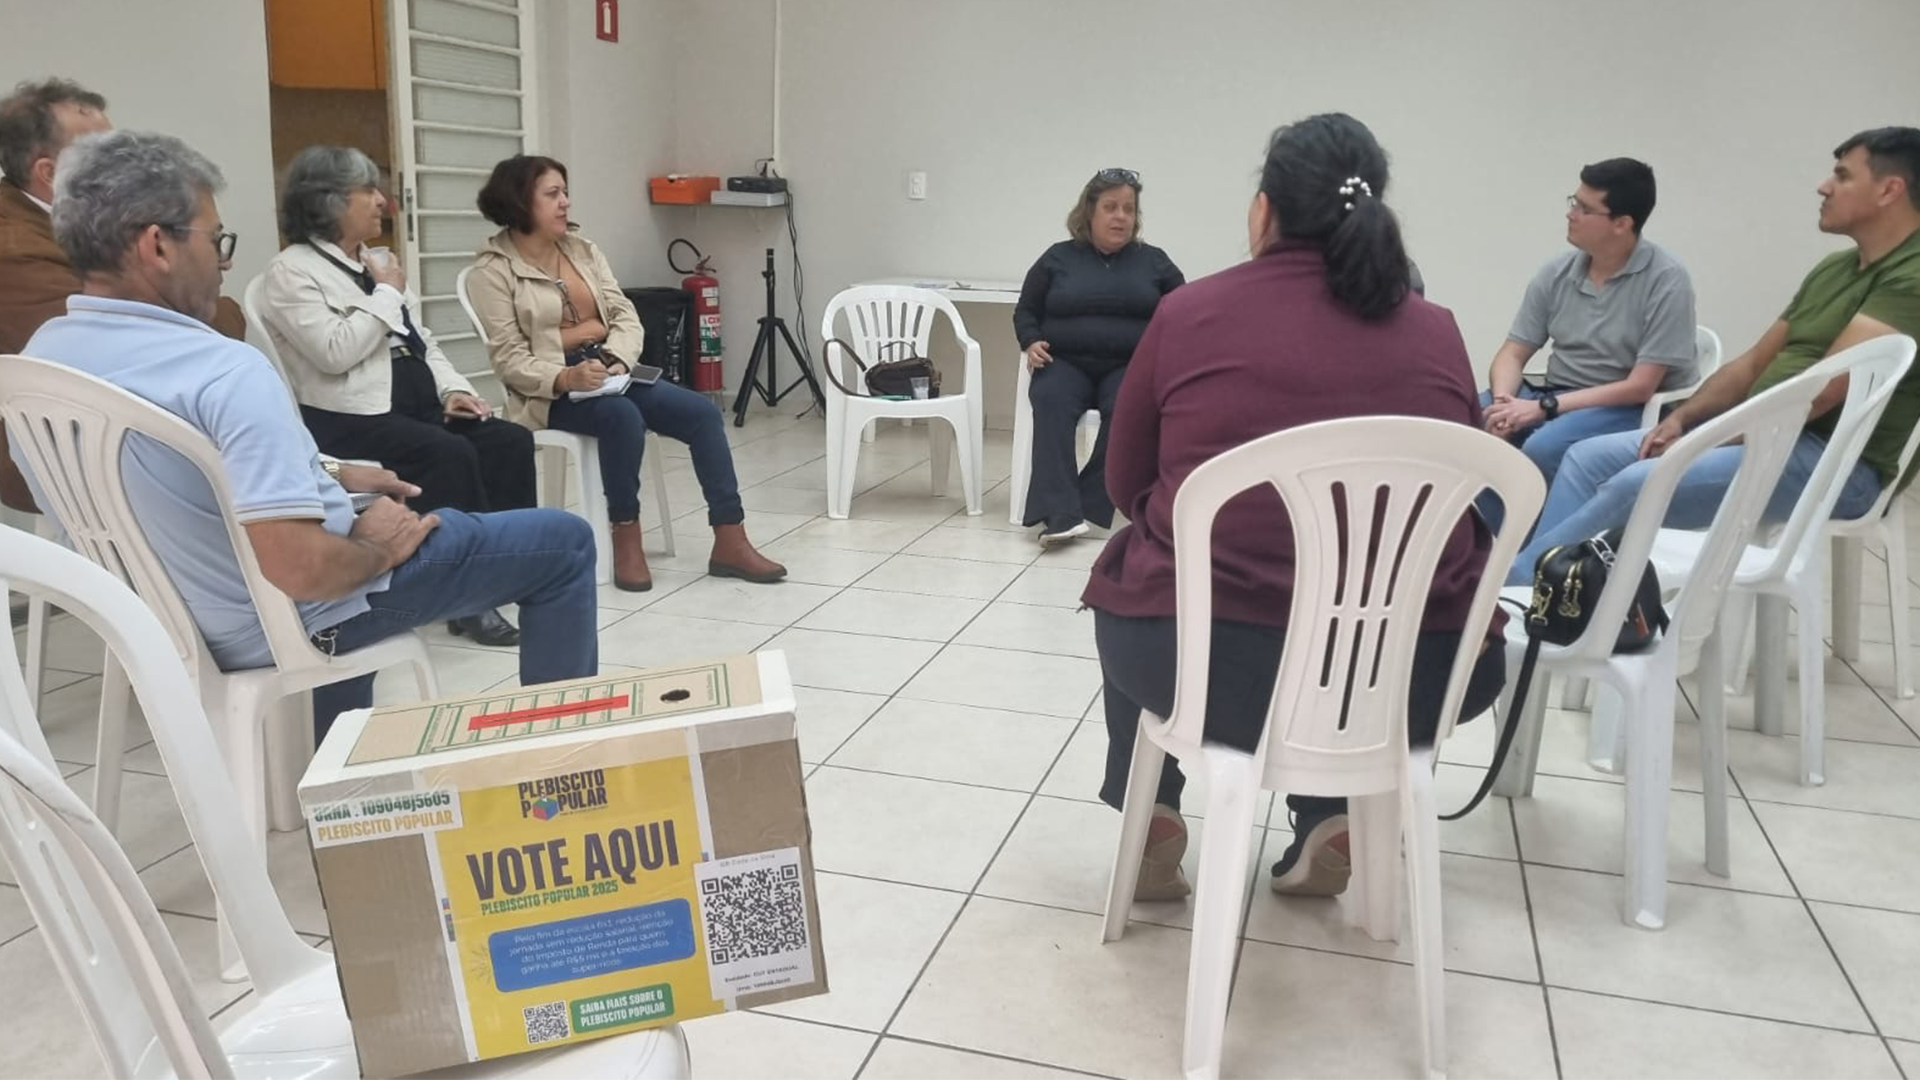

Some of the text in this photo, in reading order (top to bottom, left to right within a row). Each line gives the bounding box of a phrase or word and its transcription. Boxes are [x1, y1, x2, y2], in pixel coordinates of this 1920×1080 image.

[518, 768, 605, 800] PLEBISCITO
[520, 787, 608, 819] PPULAR
[317, 809, 453, 842] PLEBISCITO POPULAR
[466, 819, 680, 900] VOTE AQUI
[481, 880, 619, 916] PLEBISCITO POPULAR 2025
[514, 933, 536, 944] Pelo
[588, 939, 617, 952] Renda
[580, 1001, 606, 1014] SAIBA
[606, 996, 628, 1010] MAIS
[580, 1002, 666, 1027] PLEBISCITO POPULAR
